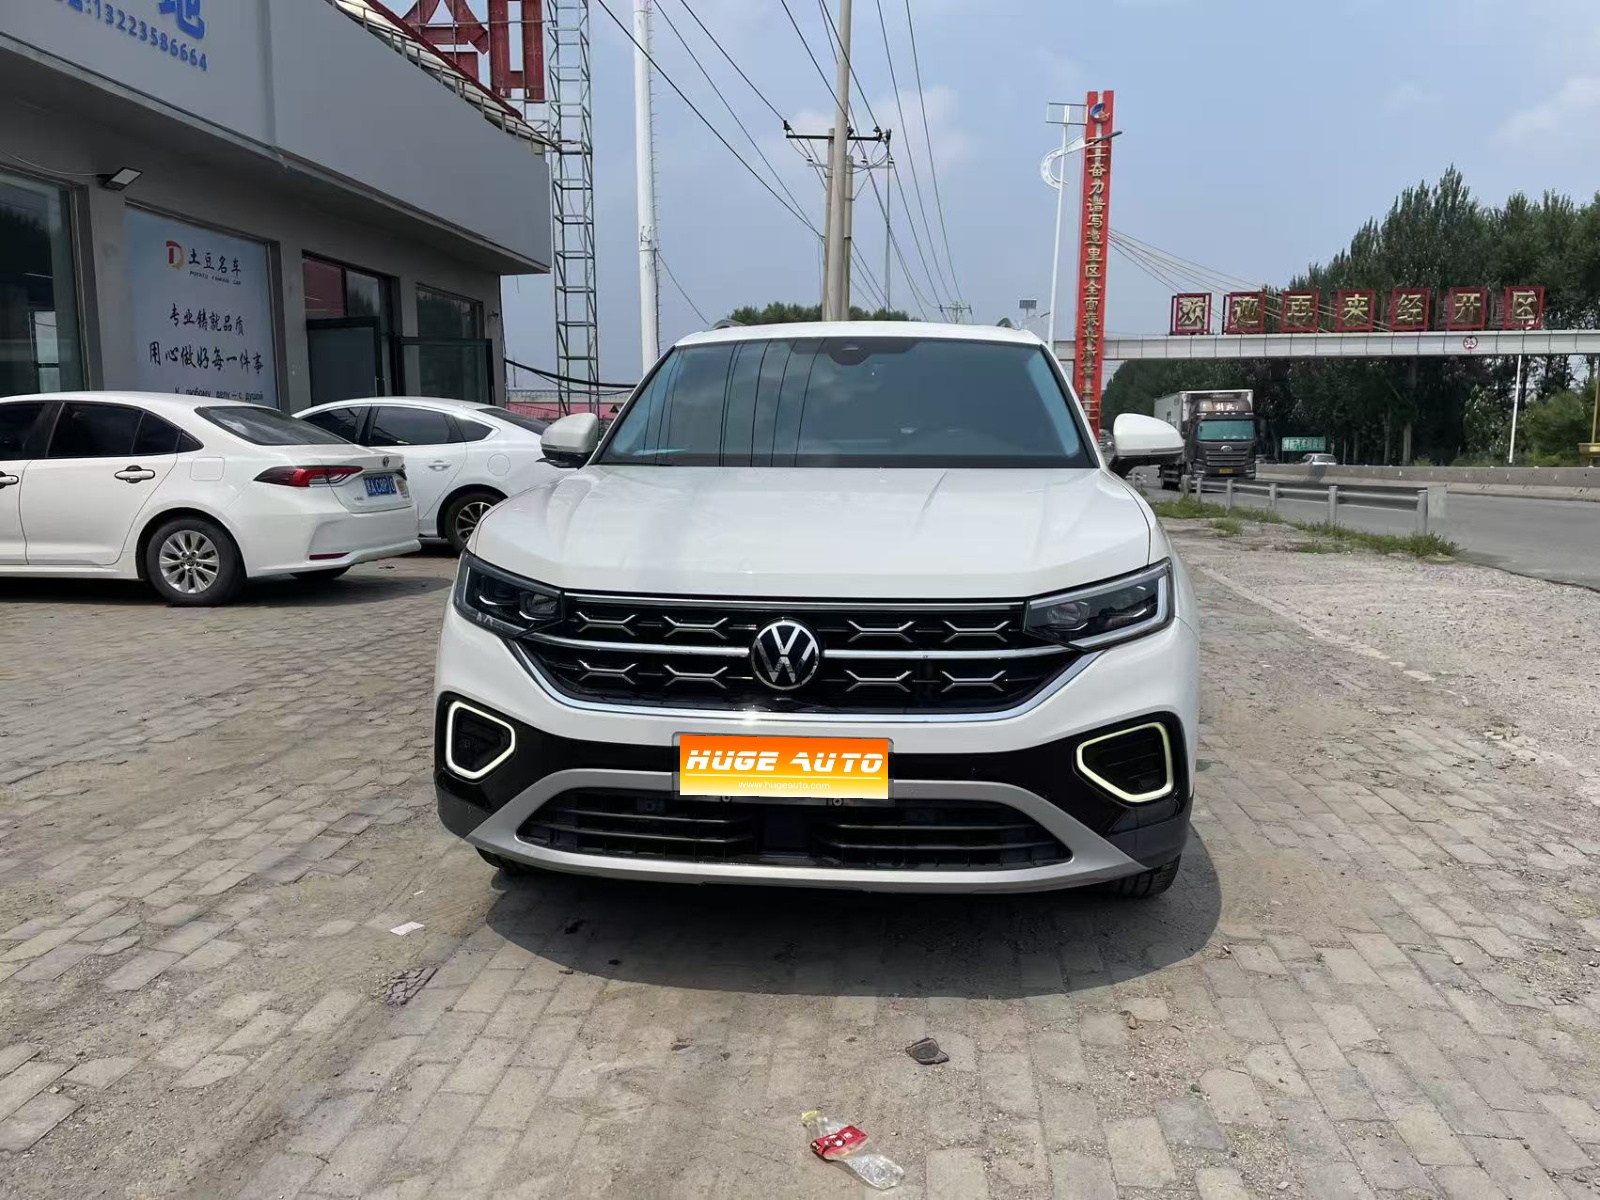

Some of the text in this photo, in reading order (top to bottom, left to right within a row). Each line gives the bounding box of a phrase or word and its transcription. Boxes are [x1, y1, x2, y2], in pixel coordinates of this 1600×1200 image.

[189, 248, 242, 277] 土豆名车
[1179, 291, 1535, 325] 欢迎再来经开区
[149, 341, 263, 374] 用心做好每一件事
